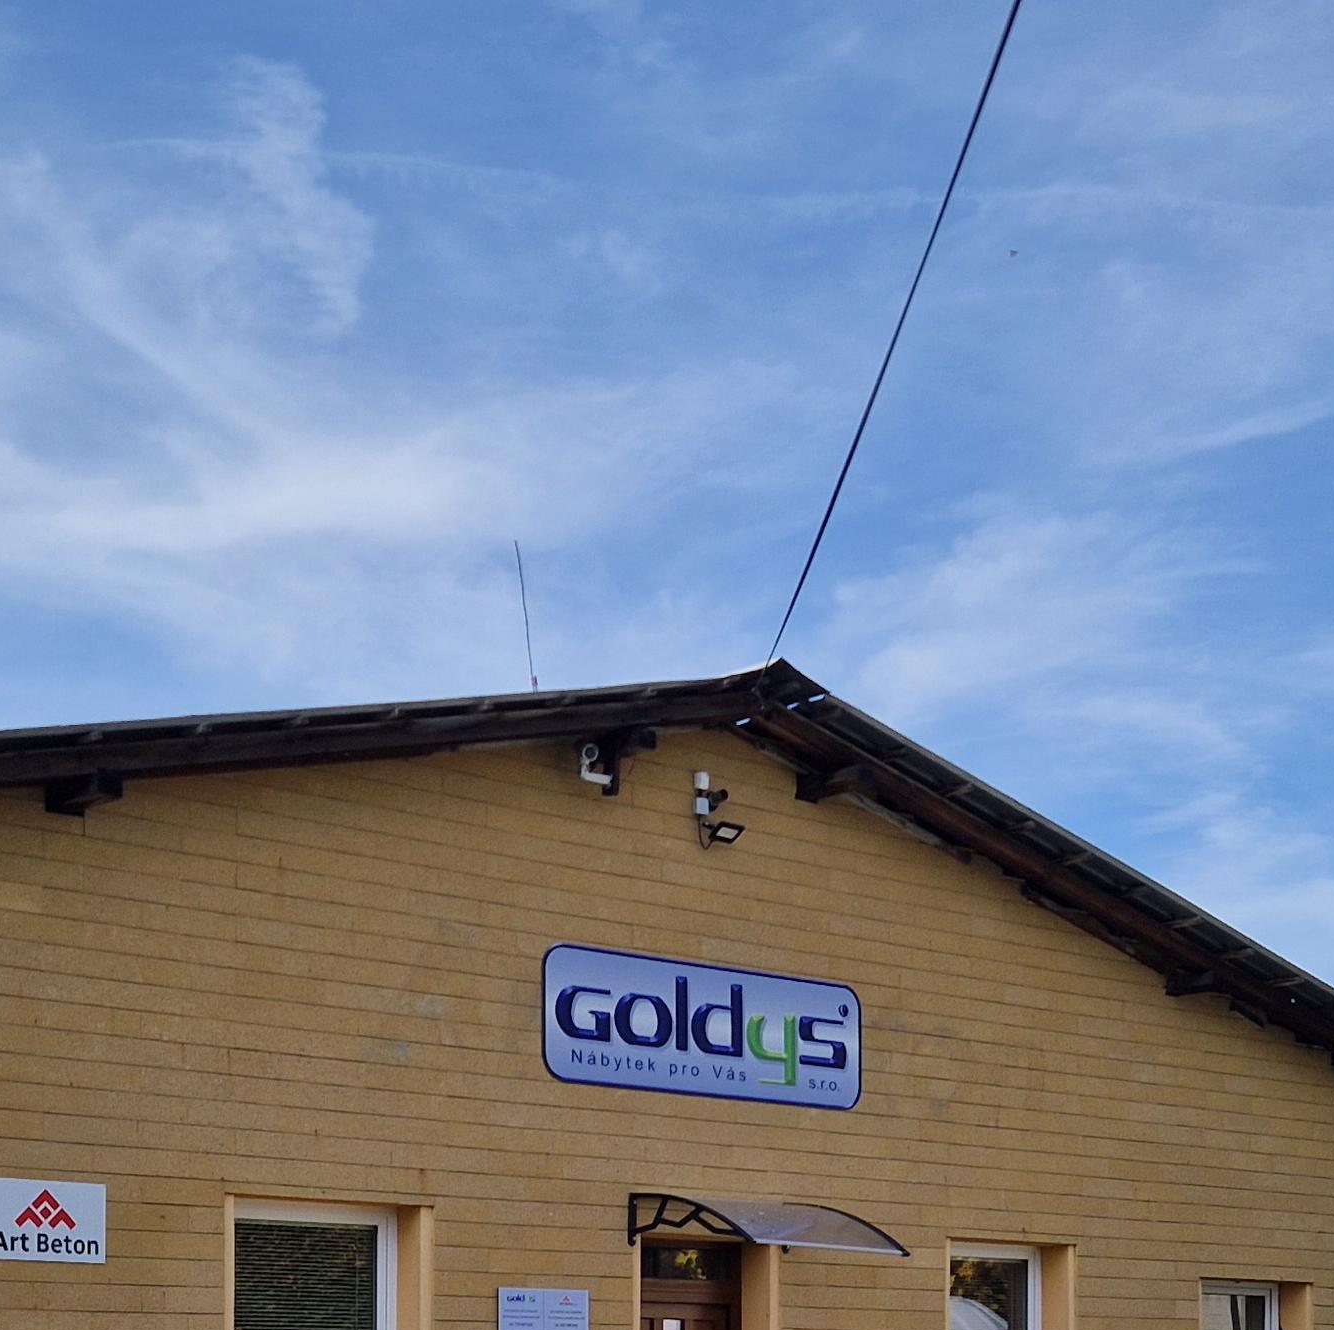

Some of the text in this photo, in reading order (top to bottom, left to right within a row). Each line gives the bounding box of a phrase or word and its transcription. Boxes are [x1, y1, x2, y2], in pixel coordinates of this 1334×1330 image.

[555, 975, 848, 1086] Goldys
[571, 1049, 747, 1082] Nábytek pro Vás
[37, 1233, 99, 1255] Beton
